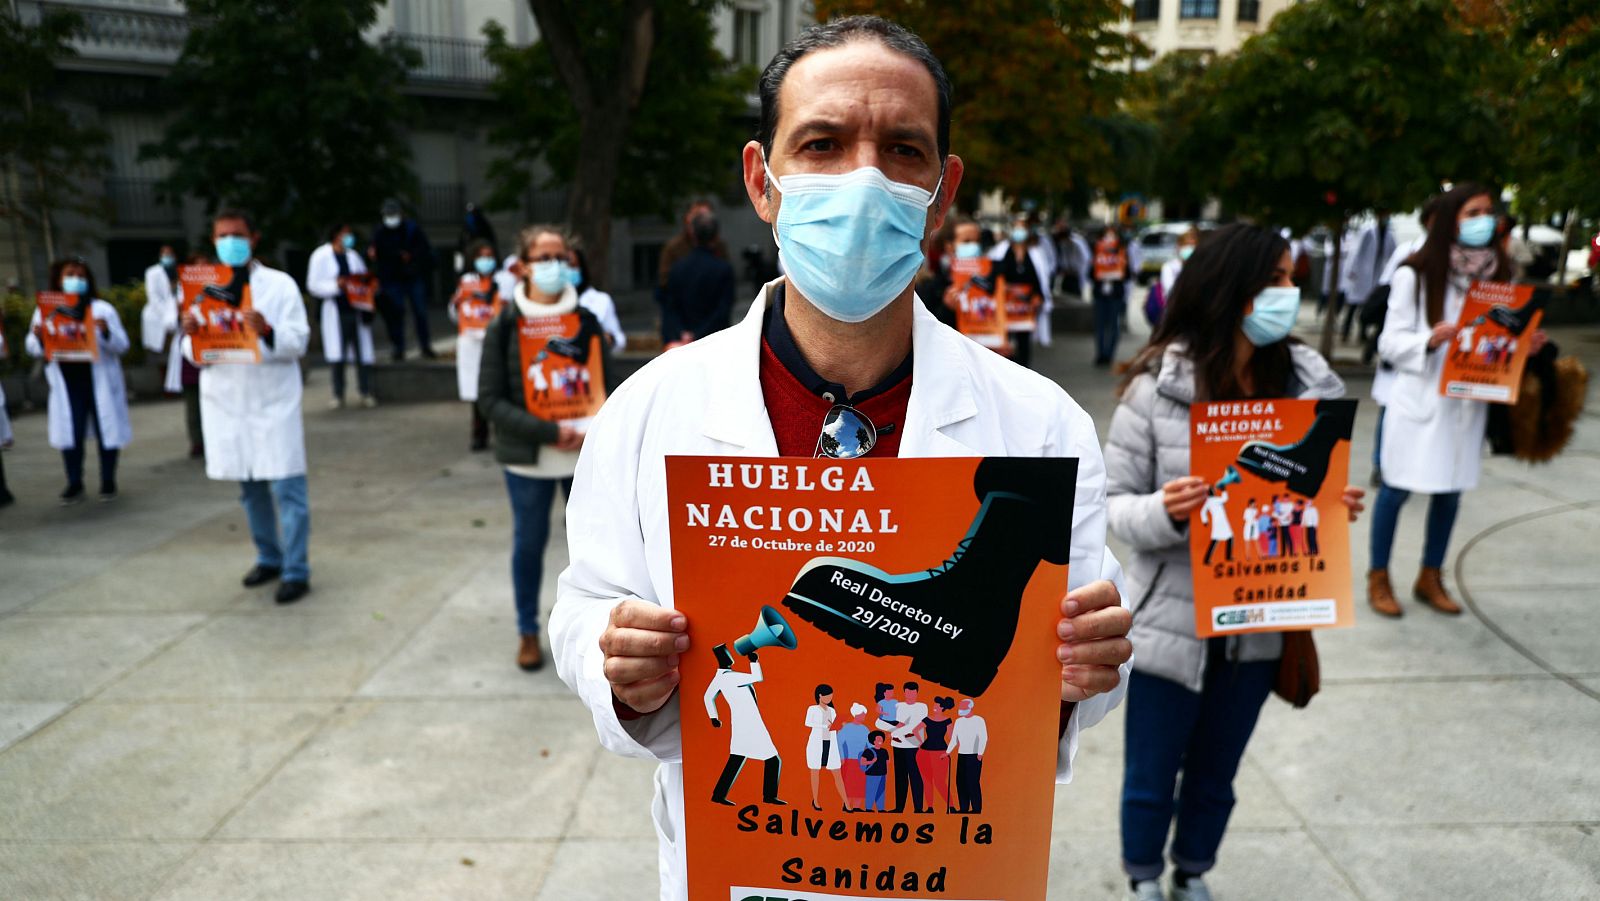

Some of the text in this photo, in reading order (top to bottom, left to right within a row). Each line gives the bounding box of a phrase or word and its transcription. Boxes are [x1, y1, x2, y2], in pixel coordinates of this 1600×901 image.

[1207, 402, 1275, 417] HUELGA
[1196, 419, 1284, 435] NACIONAL
[708, 463, 875, 491] HUELGA
[686, 503, 898, 533] NACIONAL
[708, 535, 875, 552] 27 de Octubre de 2020
[1214, 558, 1325, 578] Salvemos la
[830, 570, 963, 640] Real Decreto Ley
[1233, 584, 1307, 602] Sanidad
[851, 606, 920, 644] 29/2020
[737, 805, 993, 844] Salvemos la
[781, 857, 947, 892] Sanidad
